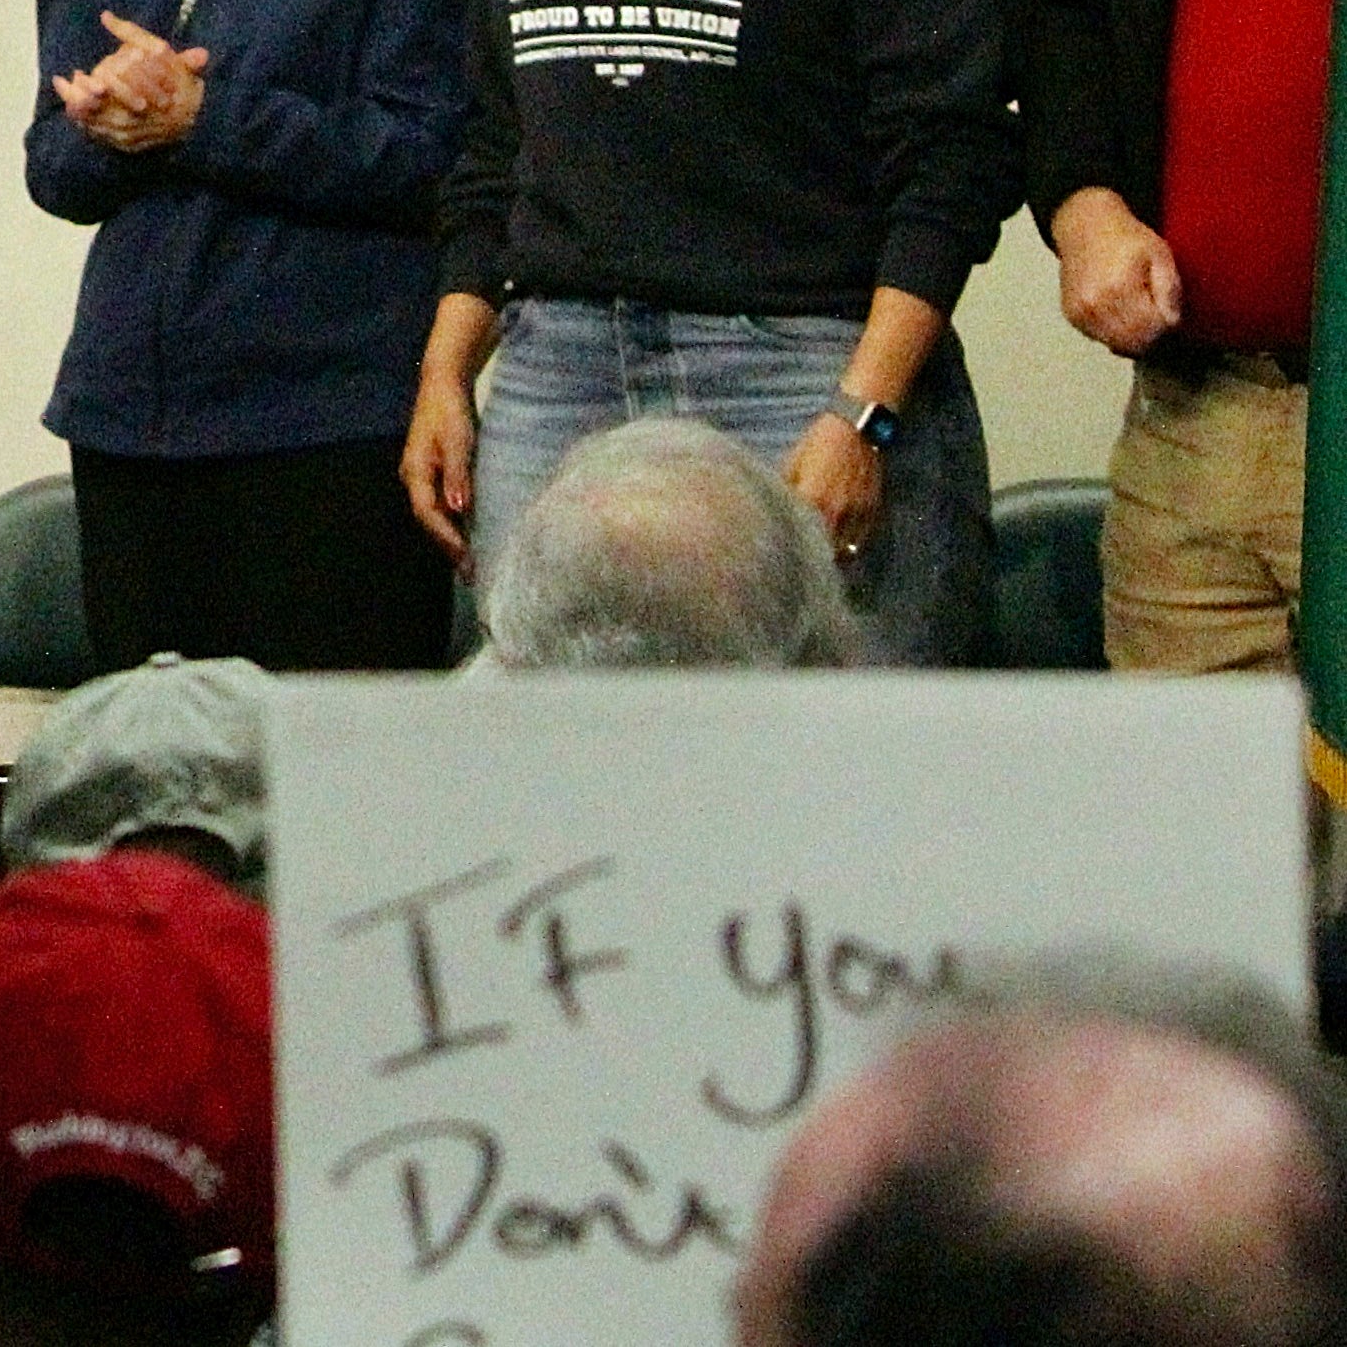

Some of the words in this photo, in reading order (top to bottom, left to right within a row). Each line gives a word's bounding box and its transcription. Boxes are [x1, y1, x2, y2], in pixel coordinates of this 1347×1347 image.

[509, 6, 579, 34] PROUD
[584, 6, 614, 26] TO
[620, 6, 650, 26] BE
[656, 7, 740, 38] UNION
